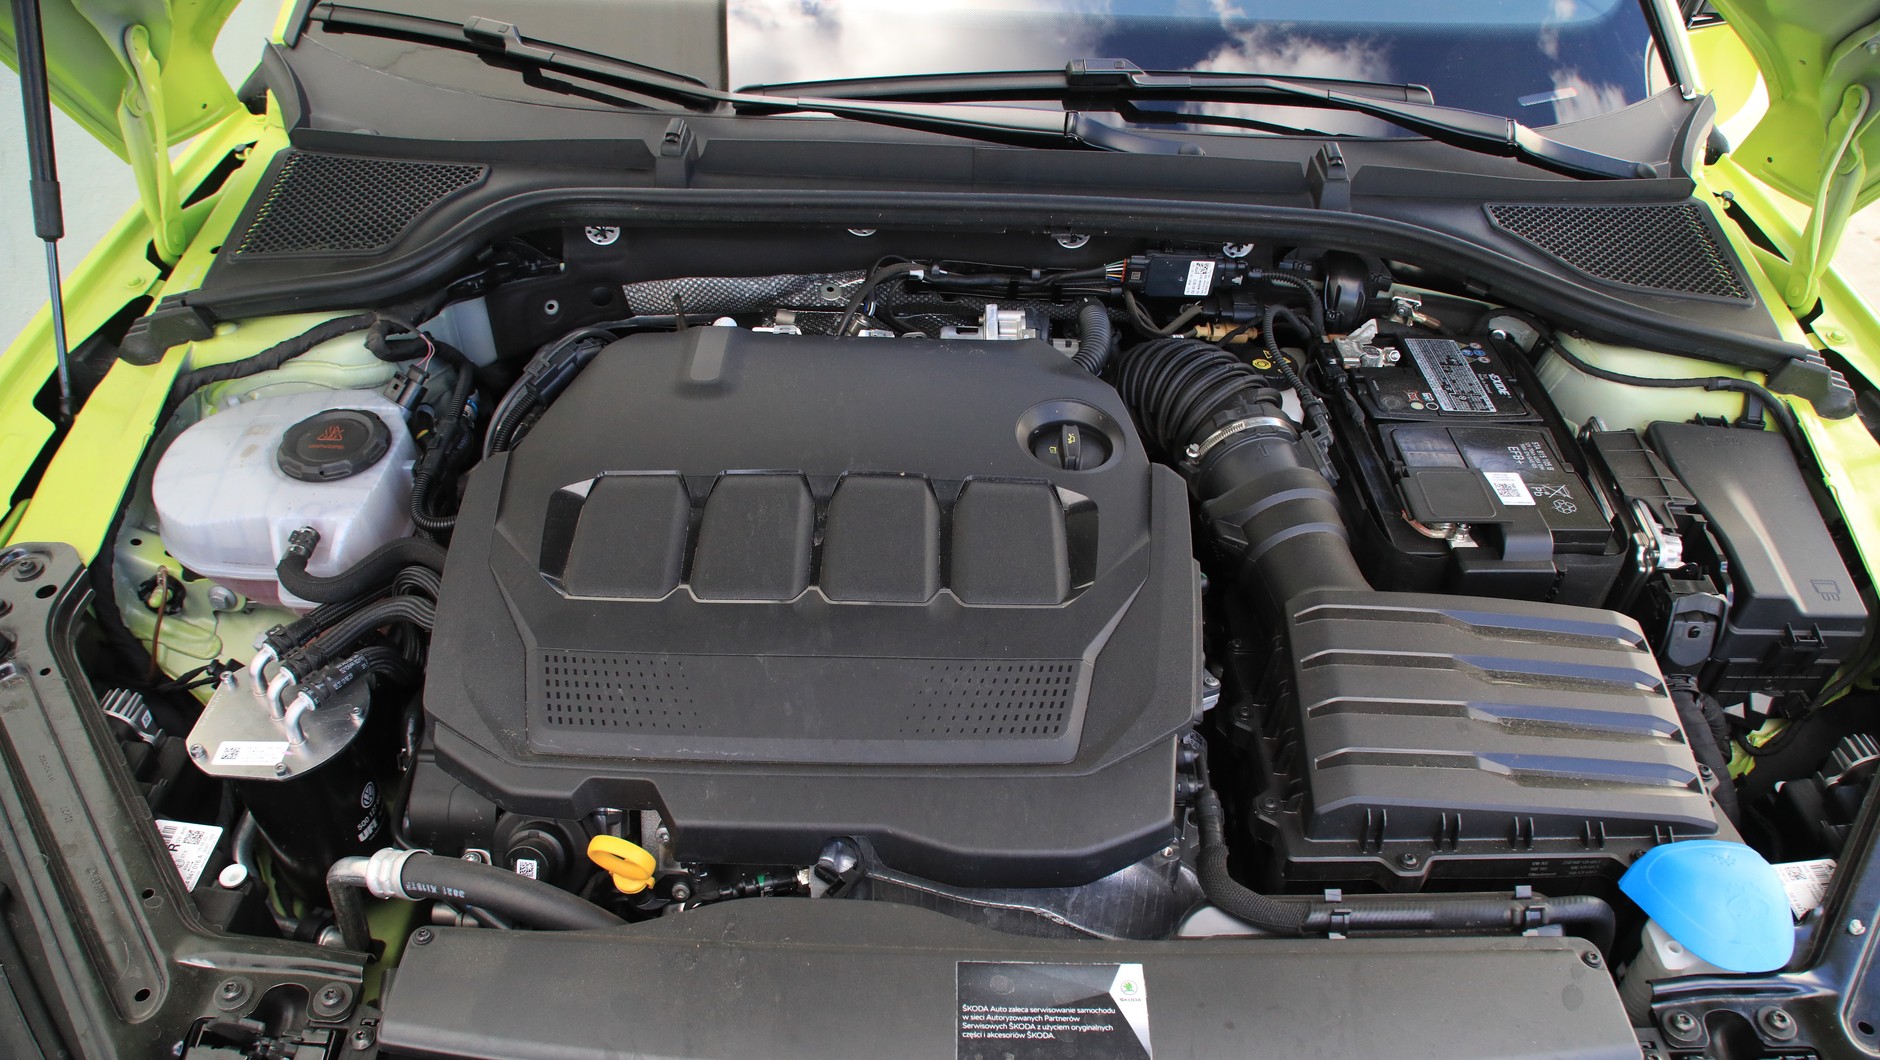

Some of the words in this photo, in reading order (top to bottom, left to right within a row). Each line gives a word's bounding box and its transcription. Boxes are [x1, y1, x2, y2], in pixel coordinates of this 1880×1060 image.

[1488, 373, 1510, 396] EXIDE
[1508, 446, 1524, 464] EFB+
[358, 818, 378, 842] UFI
[962, 1004, 989, 1013] ŠKODA
[1009, 1021, 1036, 1030] ŠKODA
[1071, 1024, 1113, 1032] oryginalnych
